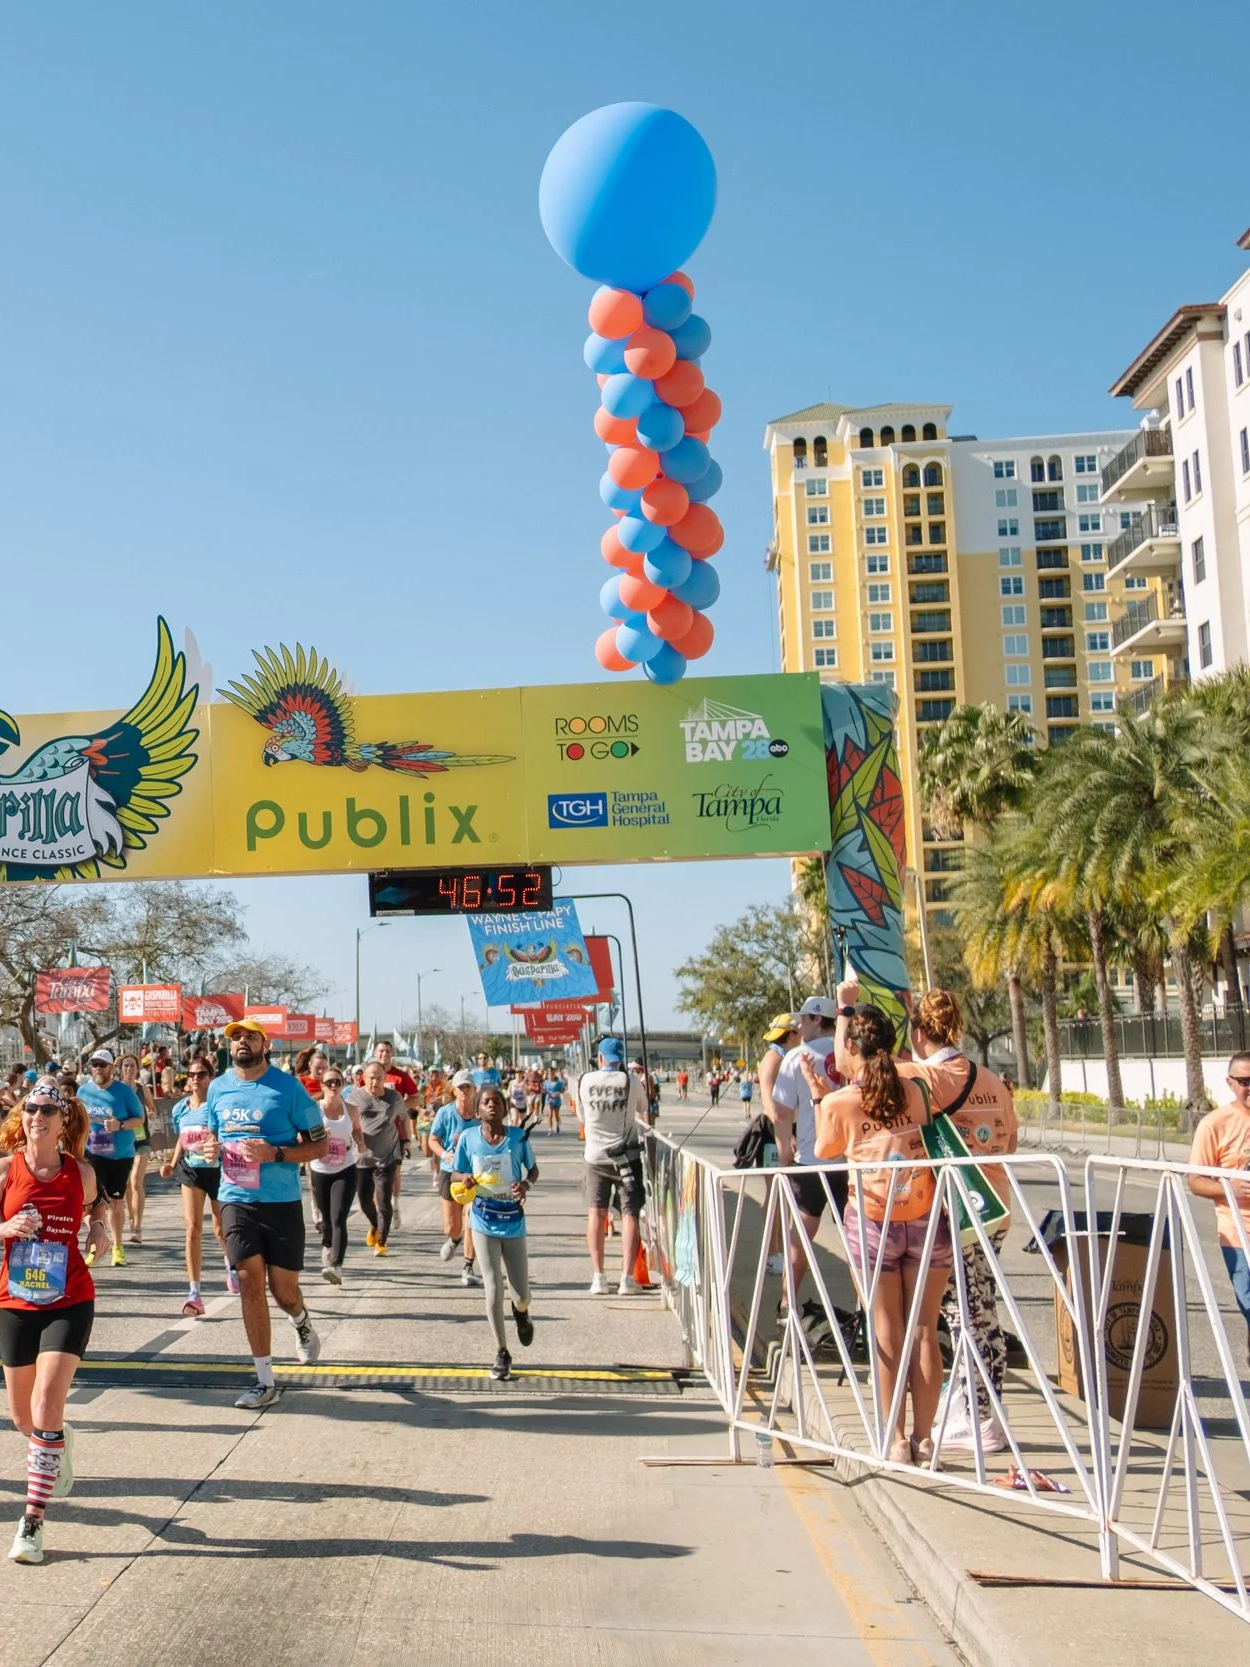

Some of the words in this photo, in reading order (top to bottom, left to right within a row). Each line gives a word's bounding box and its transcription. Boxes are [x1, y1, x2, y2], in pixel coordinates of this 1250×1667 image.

[556, 714, 639, 735] ROOMS
[680, 719, 770, 741] TAMPA
[557, 742, 585, 761] TO
[590, 741, 629, 760] GO
[686, 741, 737, 762] BAY
[742, 740, 770, 760] 28
[770, 744, 788, 753] abc
[611, 791, 658, 803] Tampa
[713, 784, 747, 798] City
[558, 800, 603, 816] TGH
[612, 803, 665, 814] General
[692, 793, 783, 824] Tampa
[246, 792, 481, 851] Publix
[612, 814, 669, 828] Hospital
[33, 845, 86, 859] CLASSIC
[471, 911, 520, 925] WAYNE
[539, 905, 572, 919] PAPY
[485, 922, 530, 936] FINISH
[534, 918, 565, 931] LINE
[512, 962, 560, 978] Gasparilla
[47, 981, 95, 1003] Tampa
[195, 1008, 227, 1018] TAMPA
[196, 1016, 215, 1025] BAY
[969, 1093, 997, 1105] ublix
[93, 1106, 104, 1115] 5K
[232, 1108, 250, 1120] 5K
[25, 1267, 46, 1281] 646
[20, 1280, 51, 1289] RACHEL
